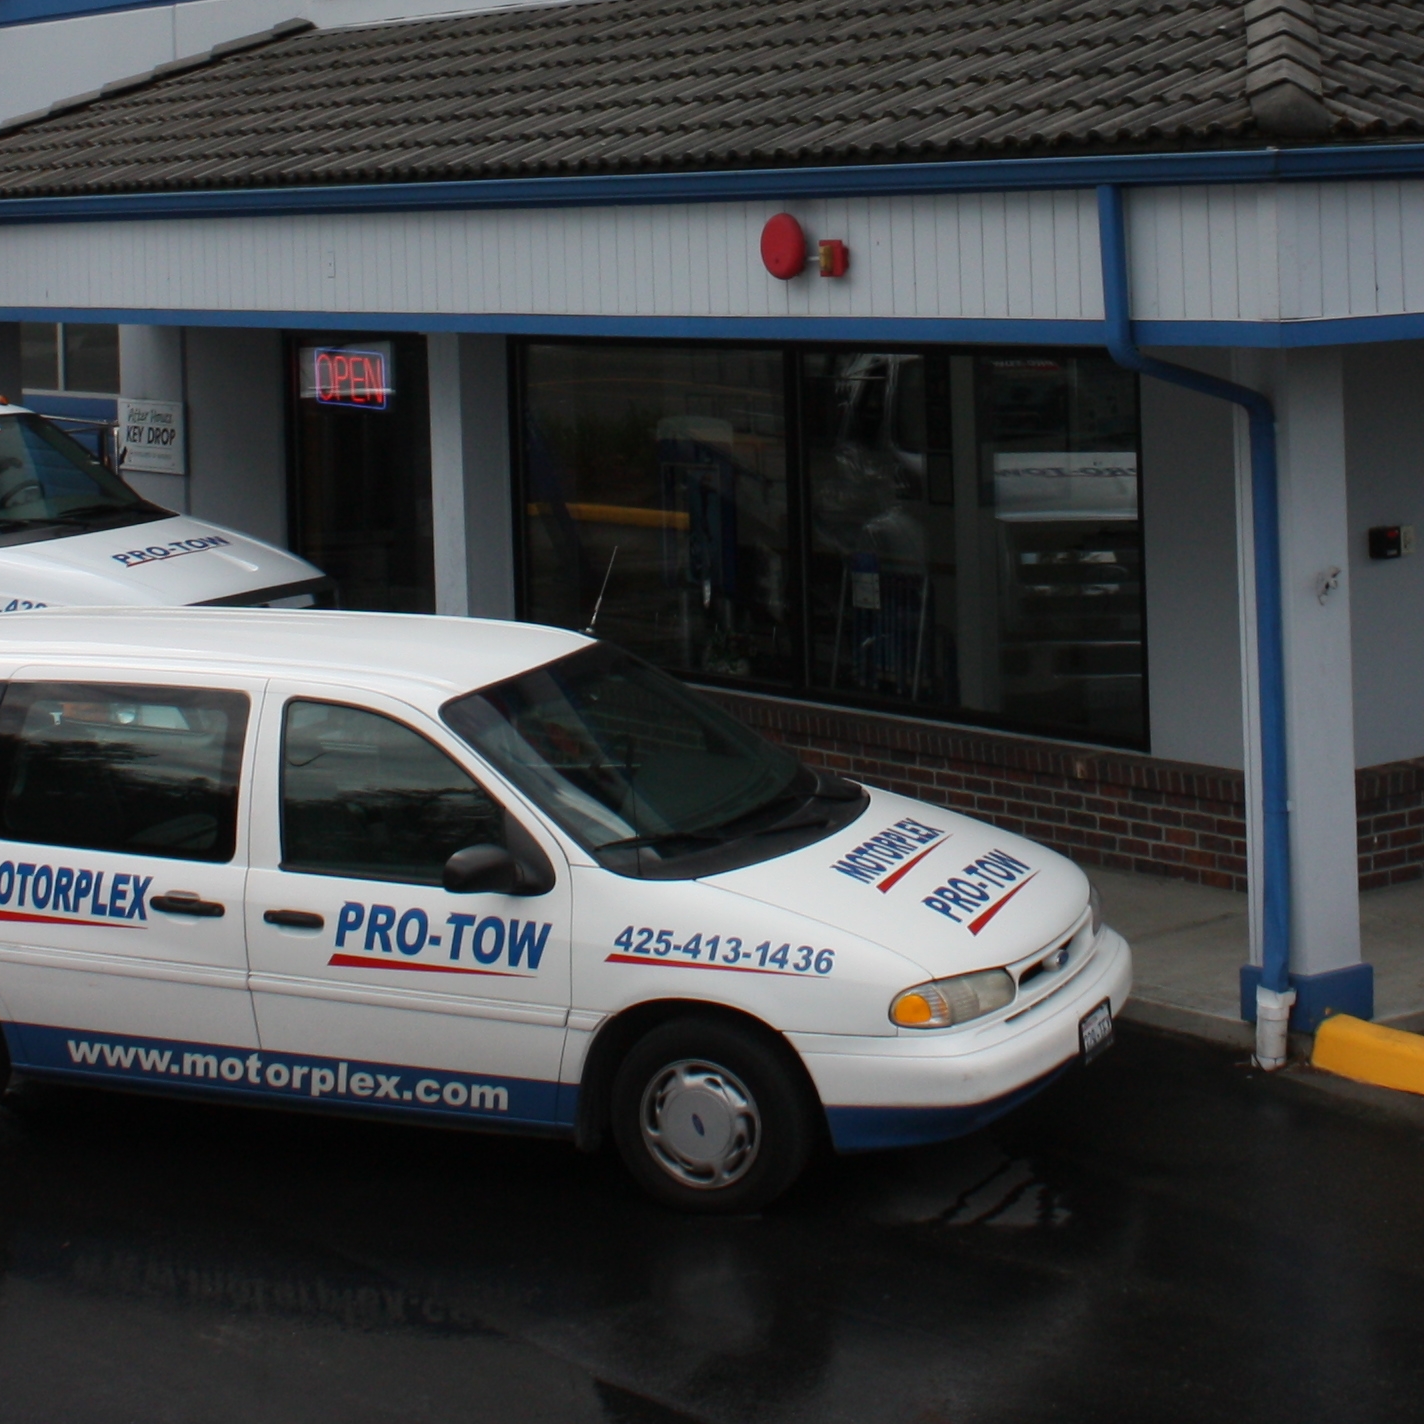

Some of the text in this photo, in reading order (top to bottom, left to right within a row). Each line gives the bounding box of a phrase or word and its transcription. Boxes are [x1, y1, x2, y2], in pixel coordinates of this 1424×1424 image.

[317, 353, 383, 403] OPEN
[126, 425, 176, 445] KEY DROP
[112, 536, 231, 564] PRO-TOW
[829, 817, 945, 884] MOTORPLEX
[921, 848, 1031, 923] PRO-TOW
[334, 900, 553, 970] PRO-TOW
[613, 925, 835, 975] 425-413-1436
[67, 1039, 509, 1111] www.motorplex.com
